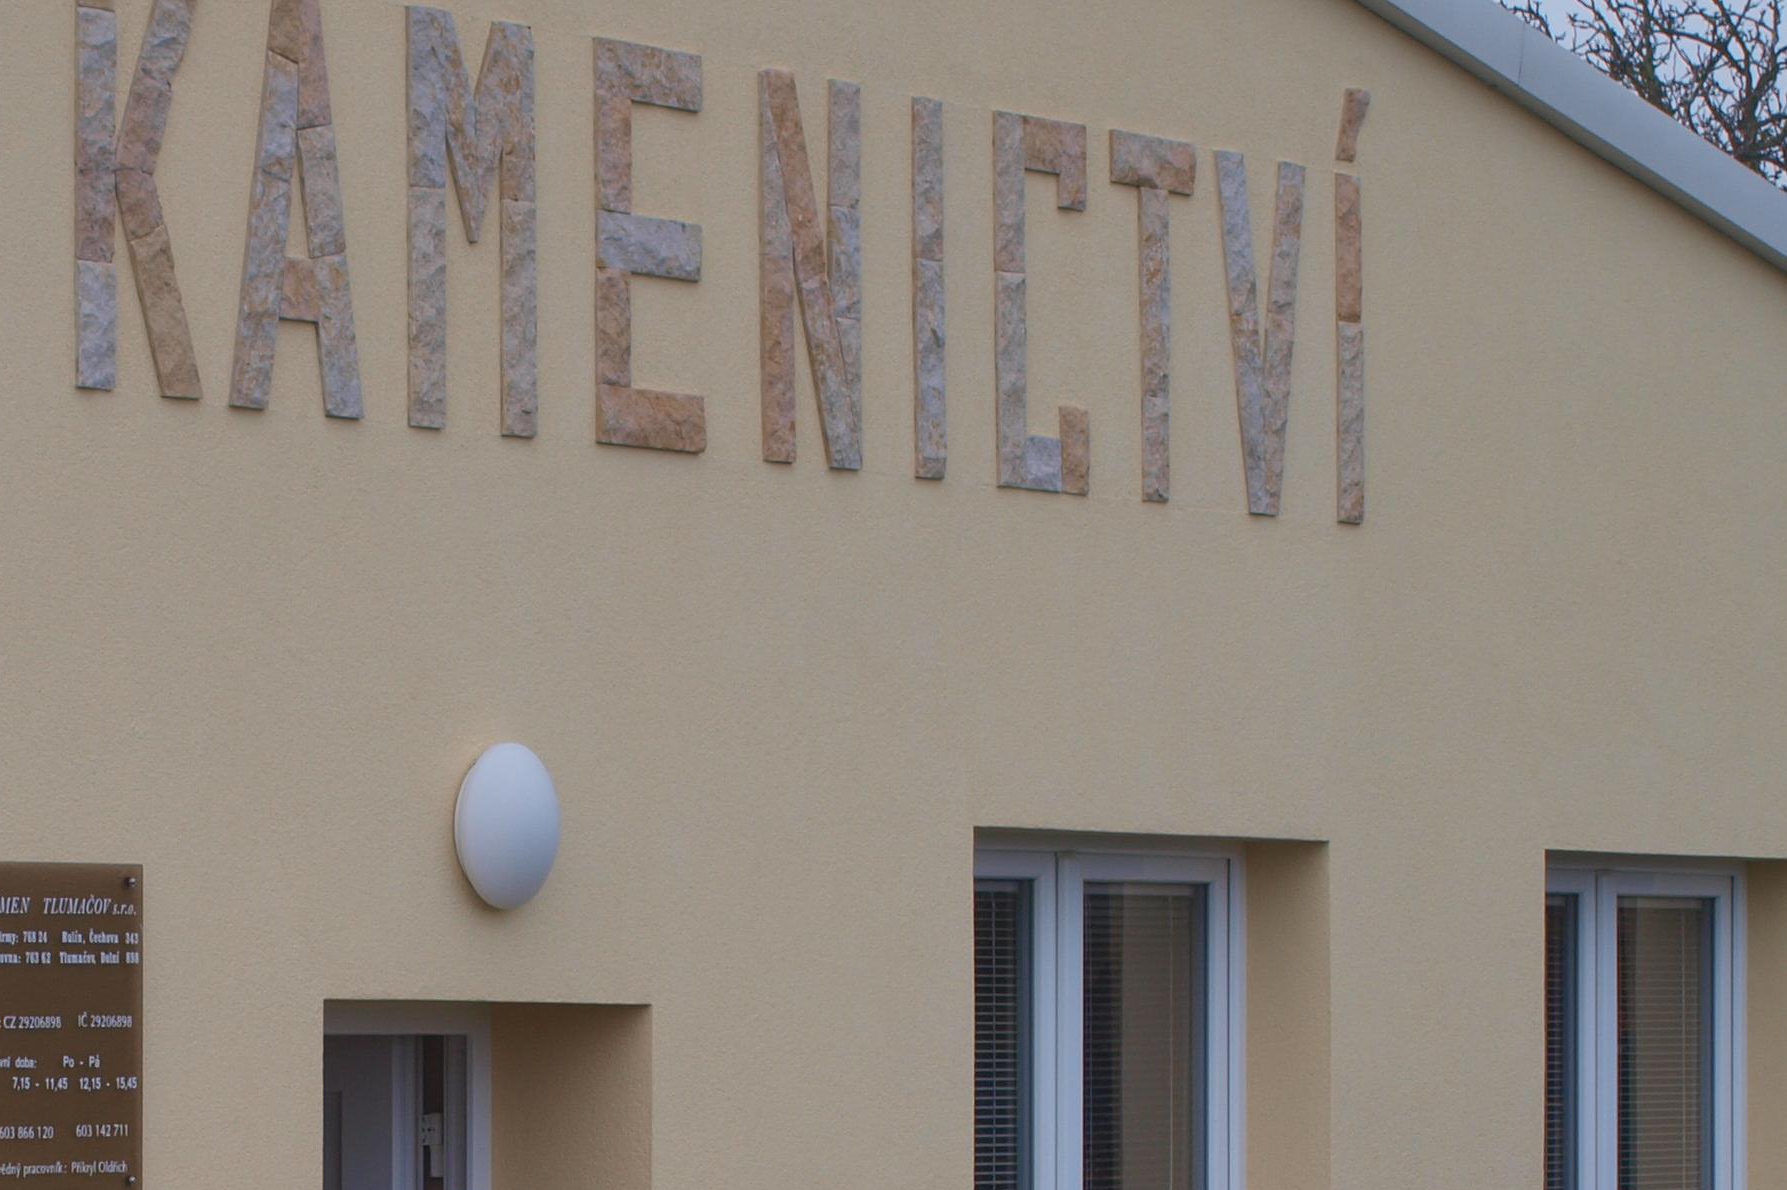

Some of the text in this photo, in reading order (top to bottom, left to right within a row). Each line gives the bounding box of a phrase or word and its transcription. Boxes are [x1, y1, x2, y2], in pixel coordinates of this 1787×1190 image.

[74, 0, 1370, 525] KAMENICTVÍ
[43, 893, 112, 915] TLUMAČOV
[112, 903, 137, 916] s.r.o.
[3, 1015, 17, 1029] CZ
[77, 1011, 88, 1028] IČ
[14, 1056, 37, 1069] doba:
[62, 1055, 75, 1069] Po
[88, 1053, 101, 1069] Pá
[12, 1076, 31, 1091] 7,15
[45, 1077, 69, 1092] 11,45
[79, 1076, 102, 1092] 12,15
[115, 1075, 138, 1091] 15,45
[17, 1126, 35, 1139] 866
[37, 1125, 55, 1139] 120
[76, 1123, 93, 1137] 603
[95, 1123, 111, 1137] 142
[113, 1123, 129, 1137] 711
